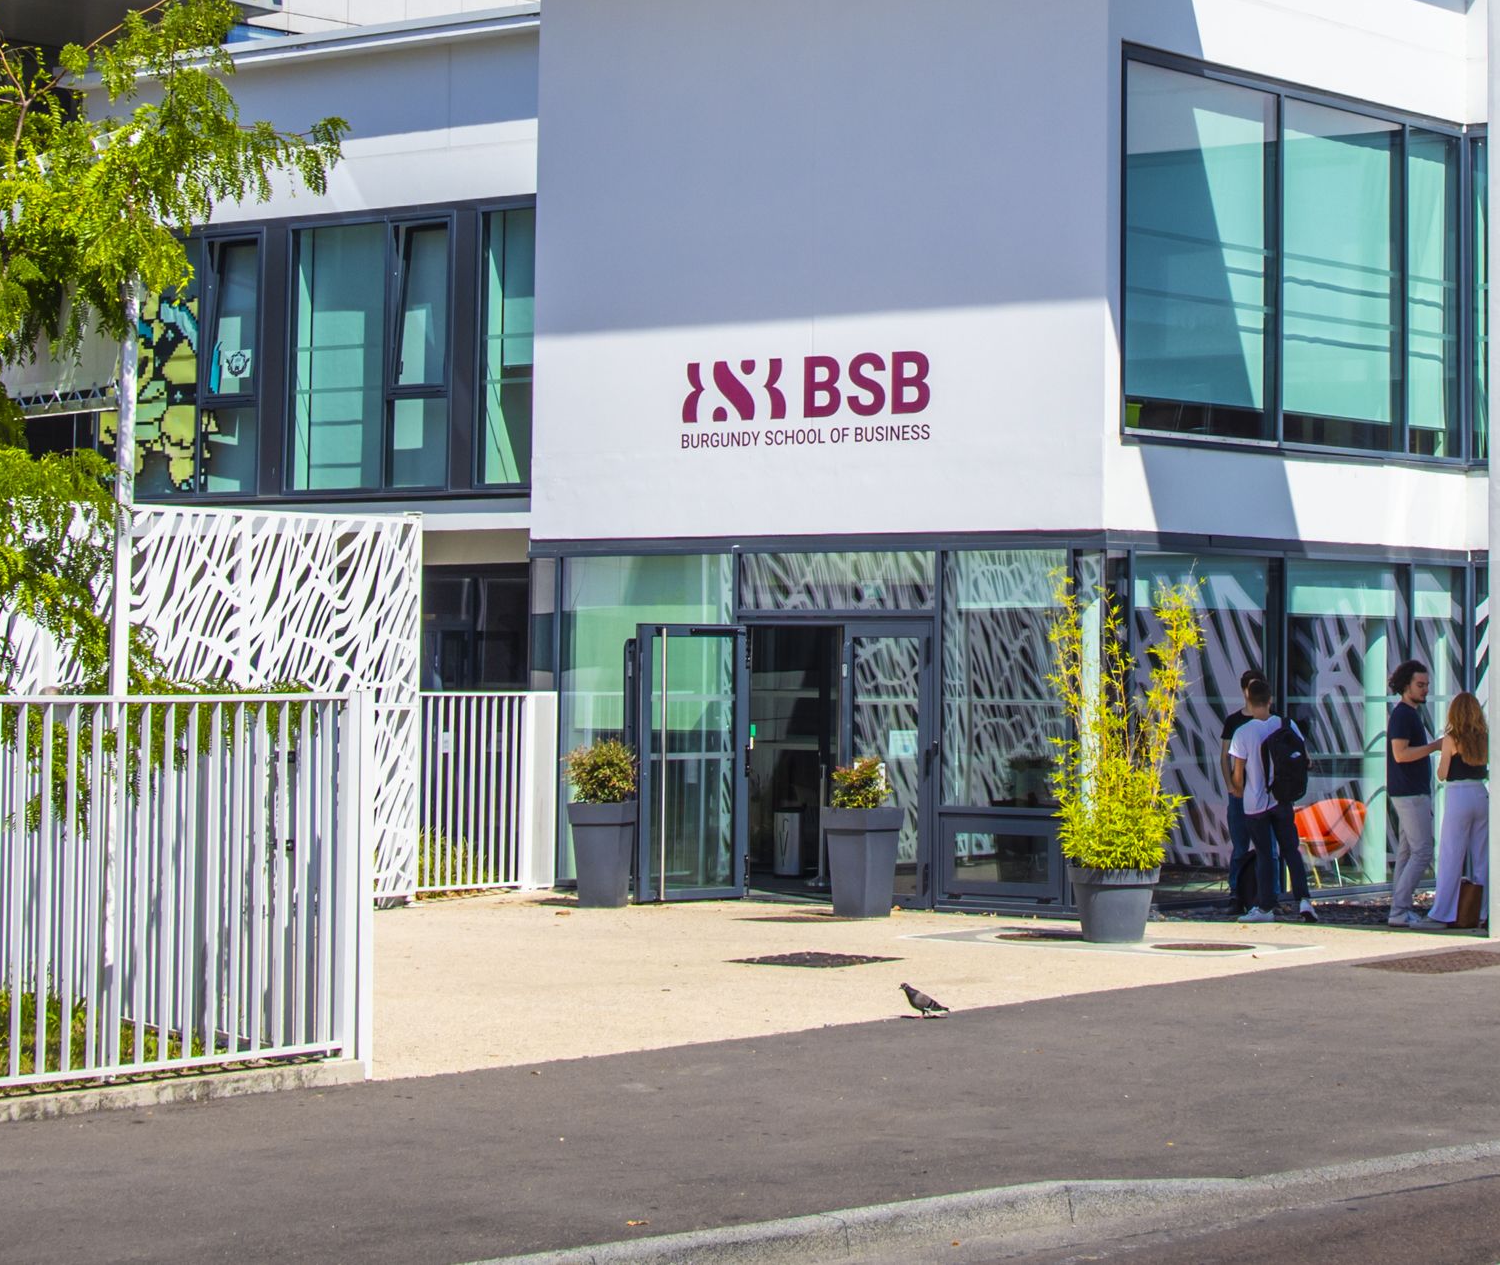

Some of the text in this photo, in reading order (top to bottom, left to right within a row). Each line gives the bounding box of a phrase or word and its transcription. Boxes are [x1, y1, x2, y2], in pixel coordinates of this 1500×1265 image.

[803, 350, 931, 419] BSB
[681, 424, 931, 449] BURGUNDY SCHOOL OF BUSINESS
